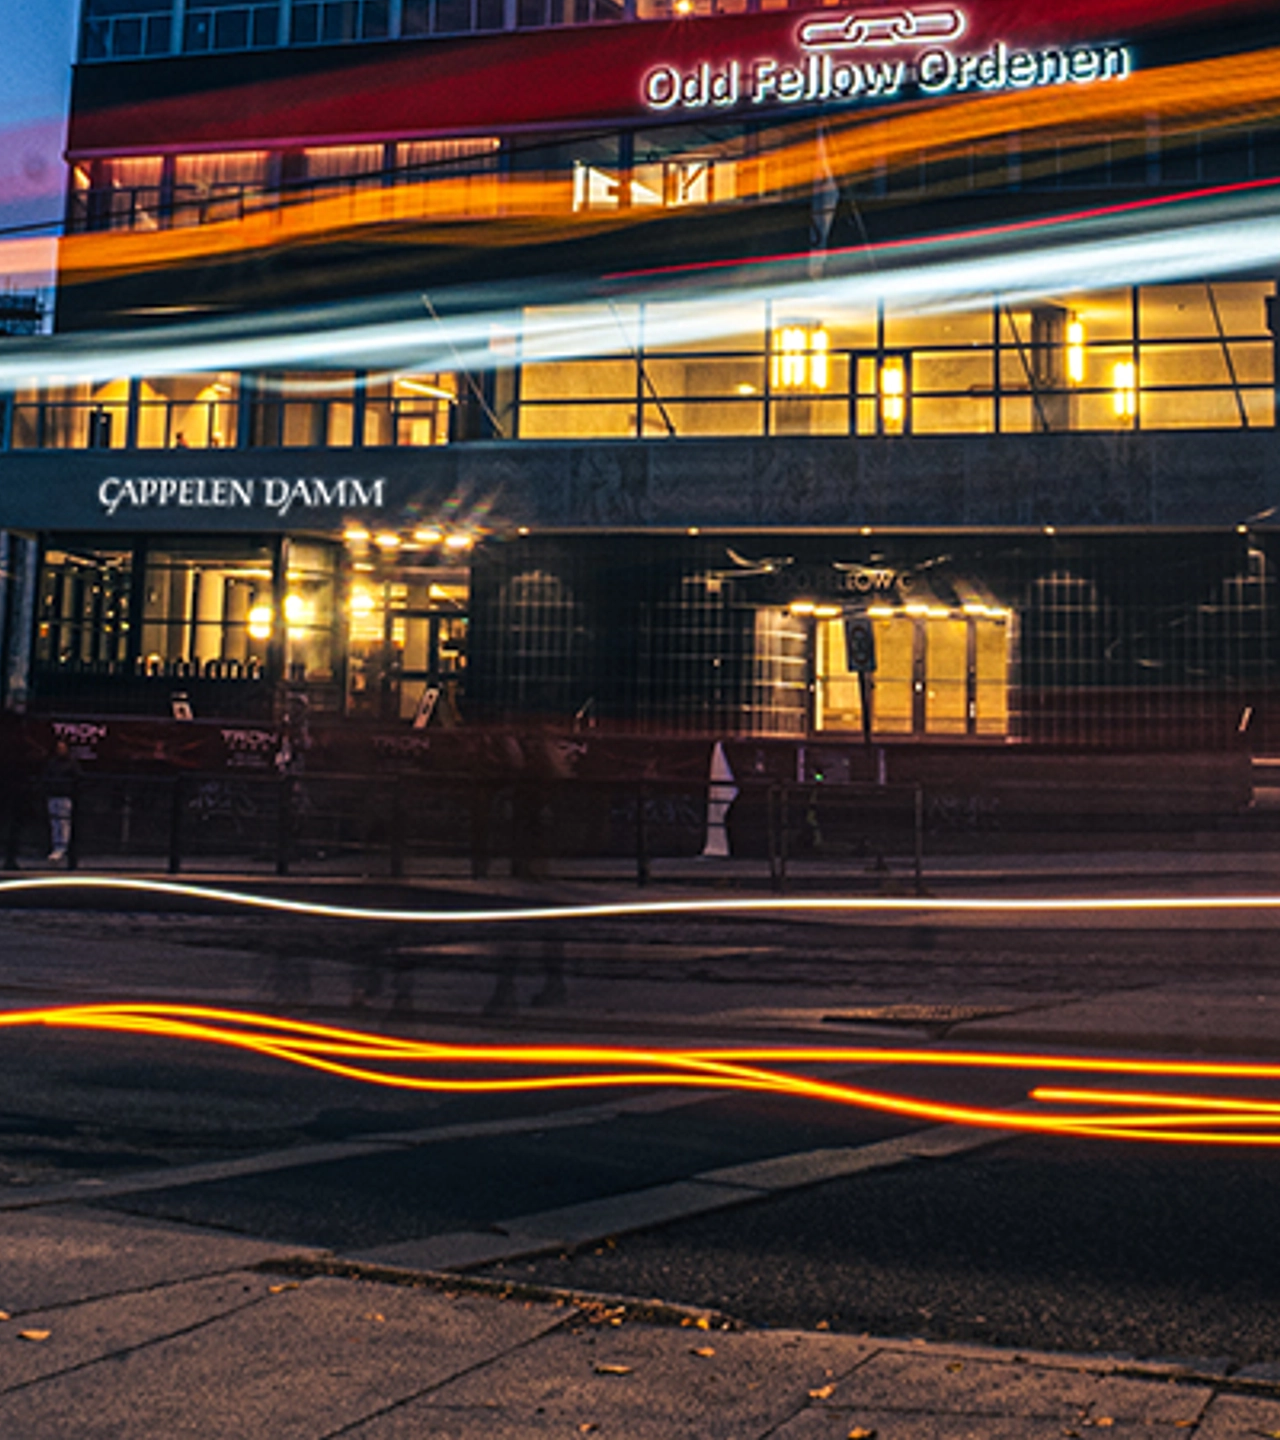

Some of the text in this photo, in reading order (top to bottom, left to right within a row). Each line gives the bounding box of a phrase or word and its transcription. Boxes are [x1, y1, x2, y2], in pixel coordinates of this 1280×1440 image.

[645, 43, 1132, 110] Odd Fellow Ordenen
[98, 476, 387, 516] CAPPELEN DAMM
